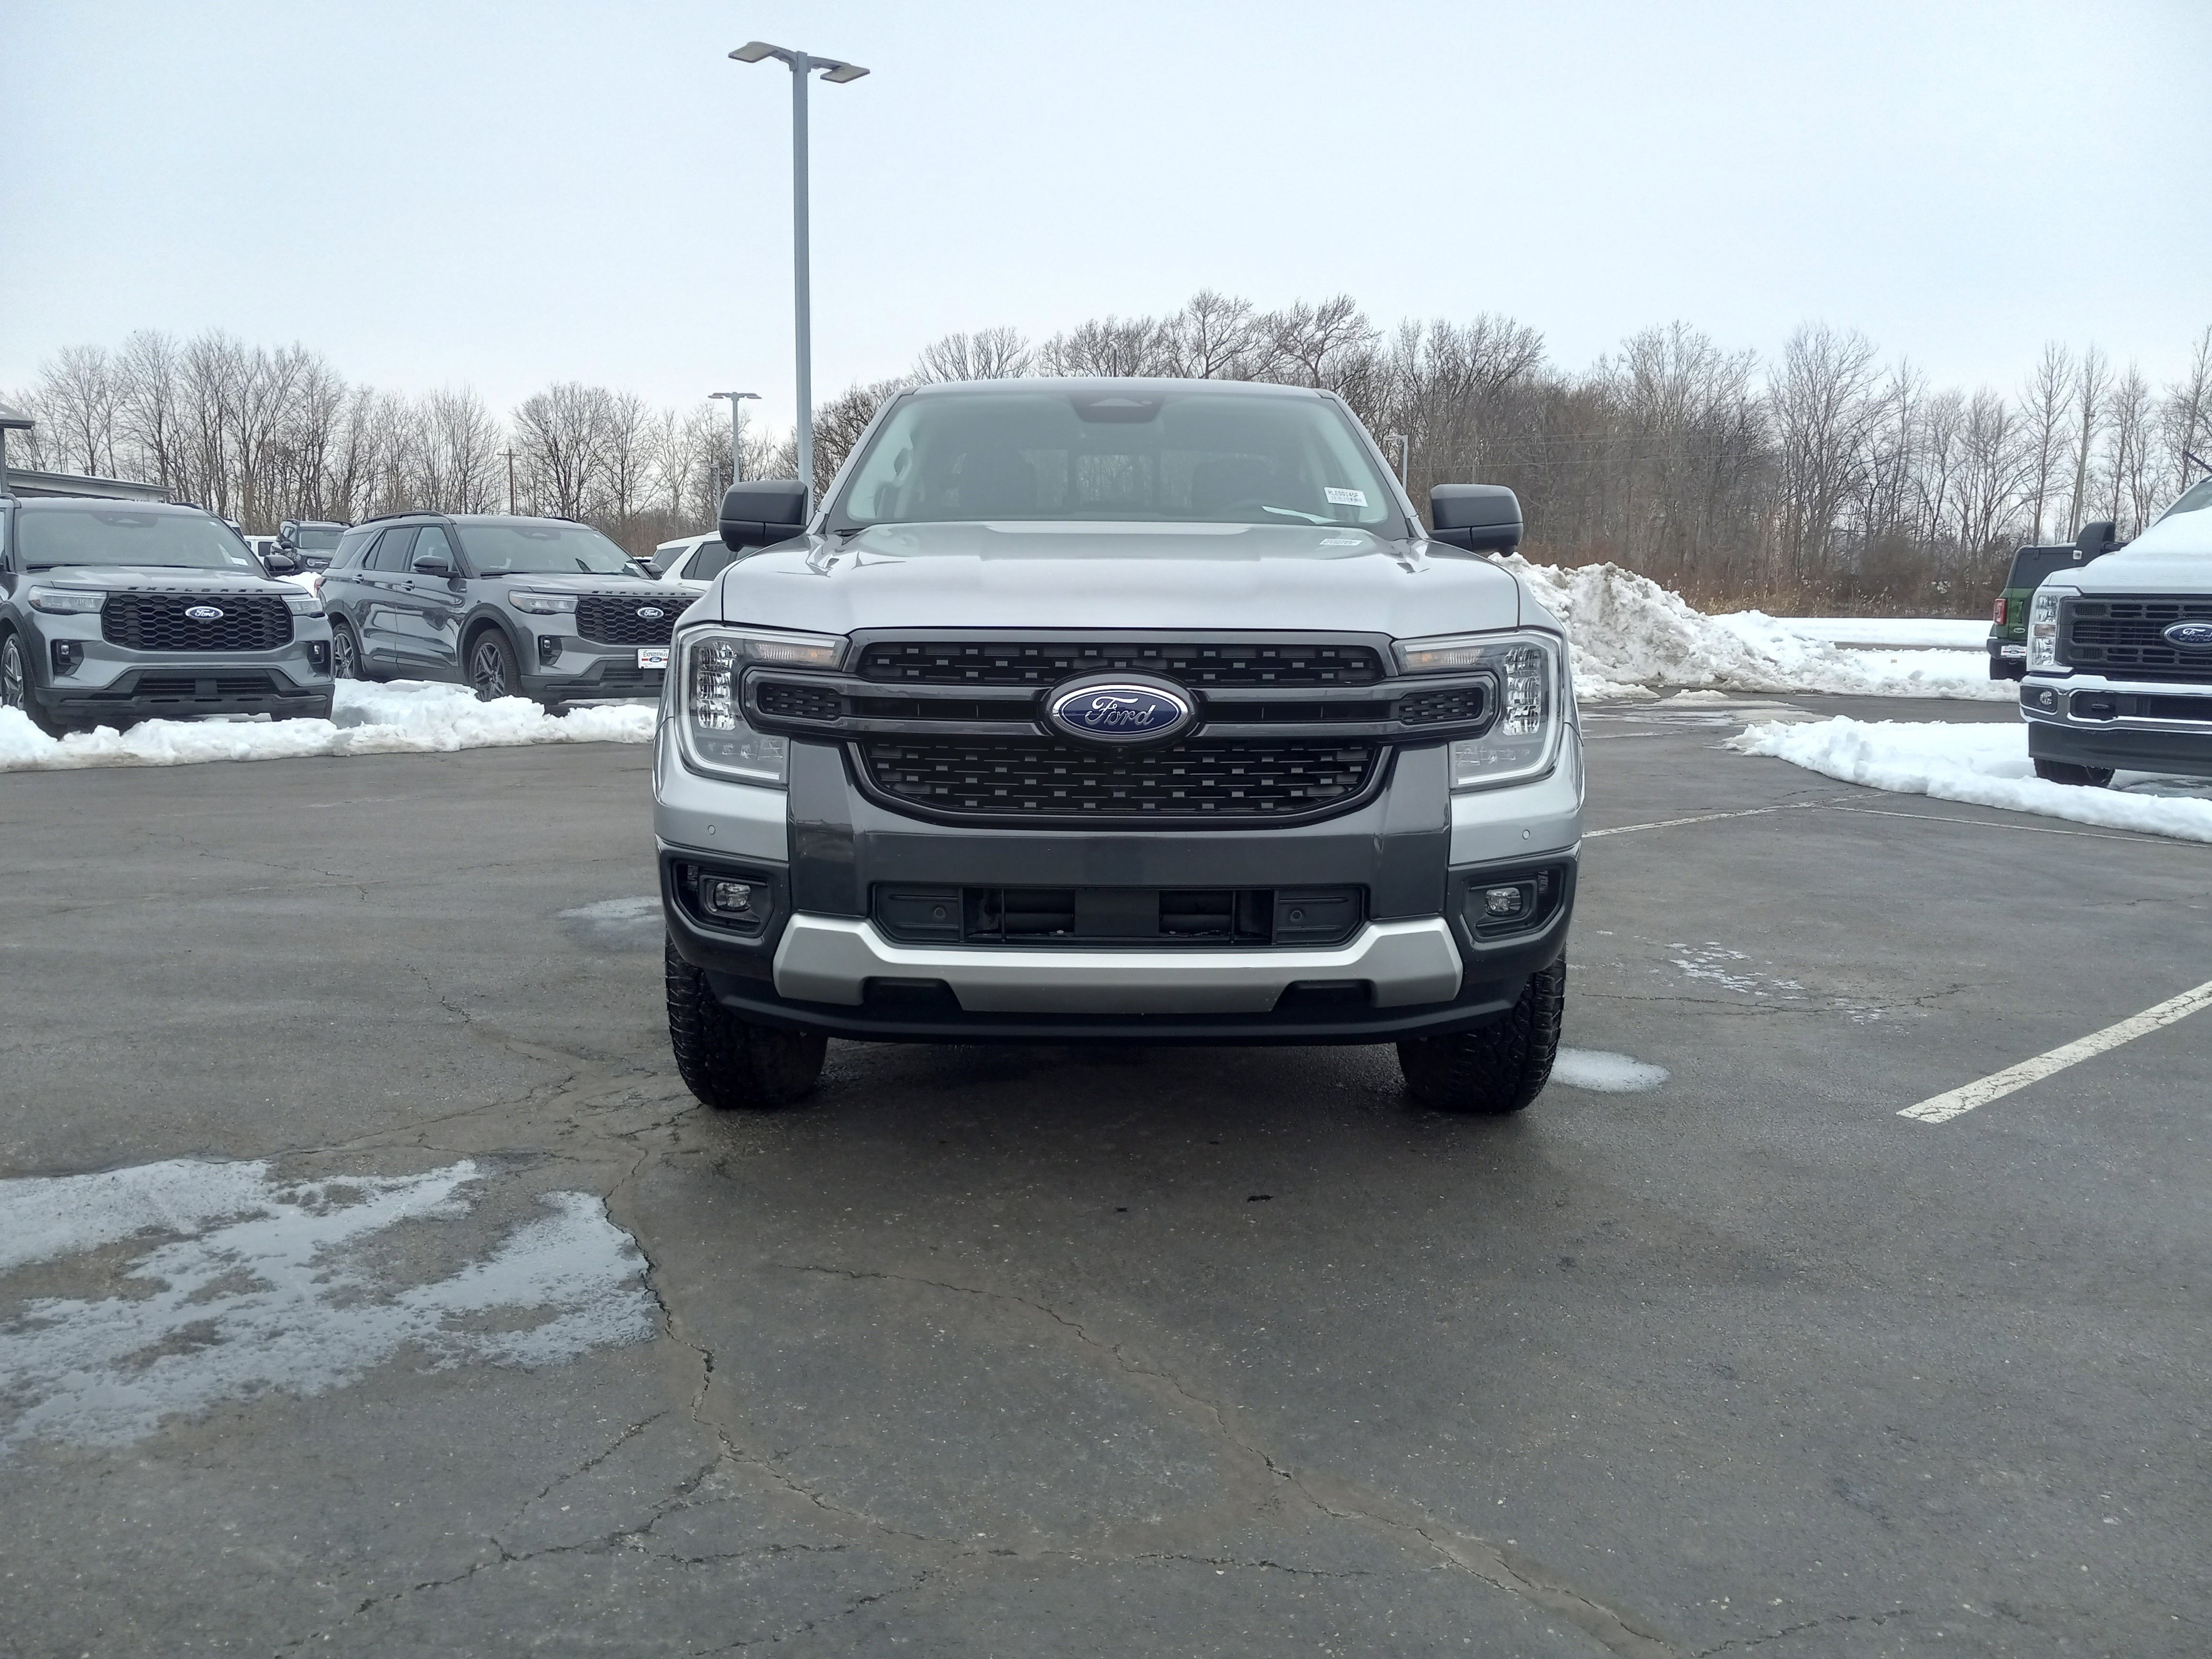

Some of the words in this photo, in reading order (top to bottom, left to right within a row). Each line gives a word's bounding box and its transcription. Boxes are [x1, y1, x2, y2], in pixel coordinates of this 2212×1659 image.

[194, 609, 216, 617] Ford
[2178, 628, 2212, 641] Ford
[1085, 696, 1156, 726] Ford
